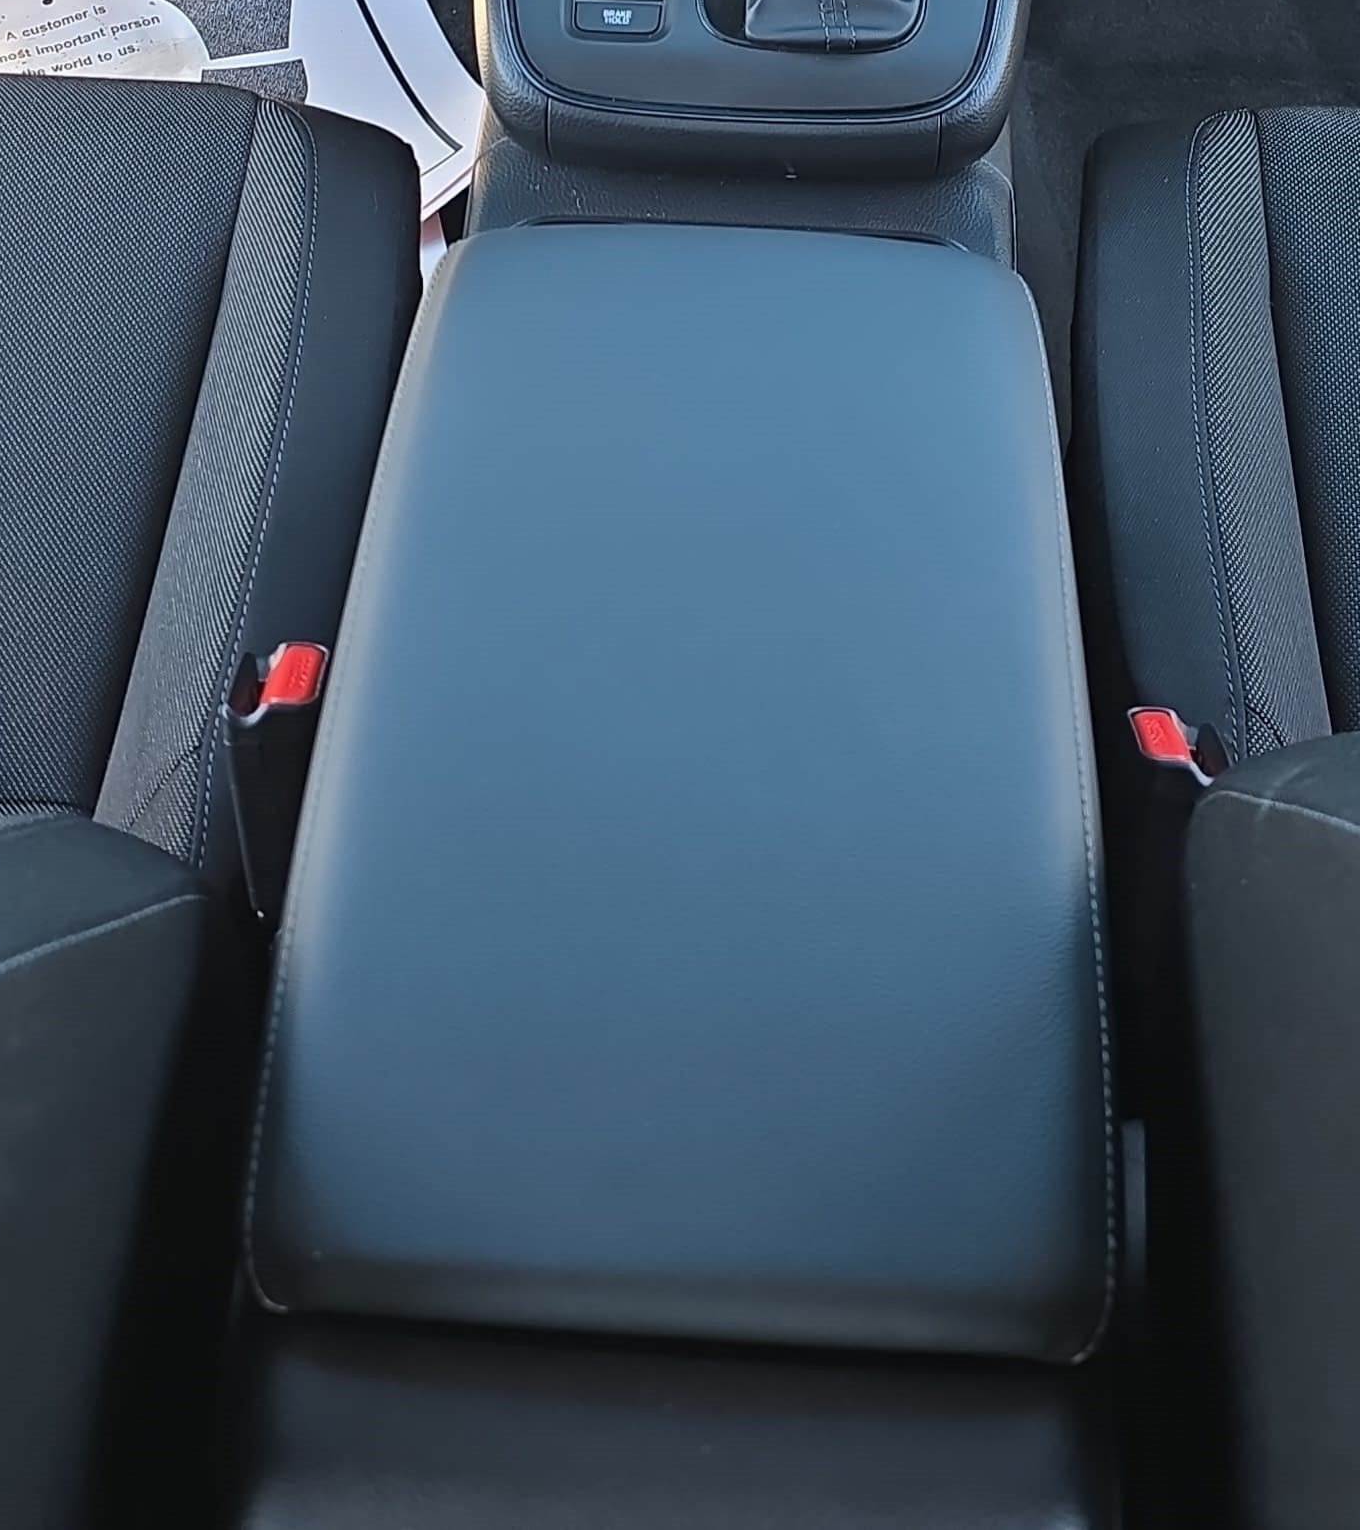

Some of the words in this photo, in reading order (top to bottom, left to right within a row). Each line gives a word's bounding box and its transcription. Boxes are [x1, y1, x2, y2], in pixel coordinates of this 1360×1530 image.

[5, 30, 18, 42] A
[21, 9, 89, 39] customer
[603, 9, 632, 18] BRAKE
[604, 16, 630, 25] HOLD
[110, 14, 161, 38] person
[50, 54, 92, 74] world
[97, 50, 113, 63] to
[117, 43, 141, 57] us.
